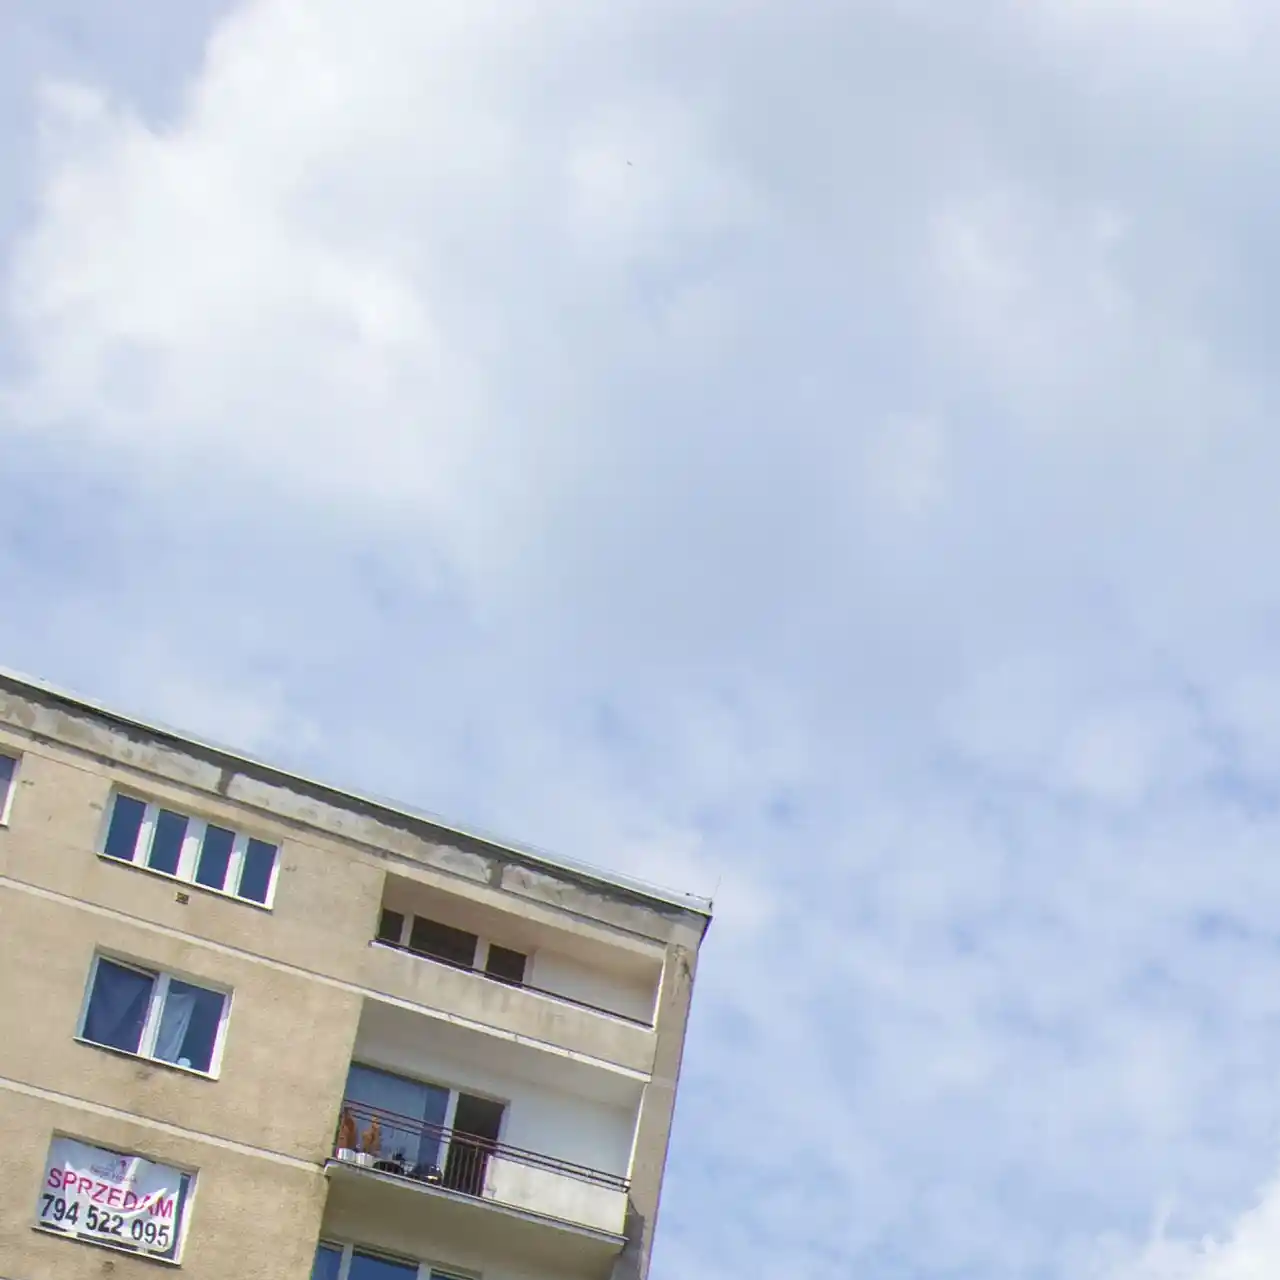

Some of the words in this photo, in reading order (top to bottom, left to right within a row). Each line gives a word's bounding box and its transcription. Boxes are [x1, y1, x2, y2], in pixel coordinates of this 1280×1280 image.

[41, 1193, 80, 1225] 794
[86, 1204, 124, 1237] 522
[131, 1218, 171, 1248] 095
